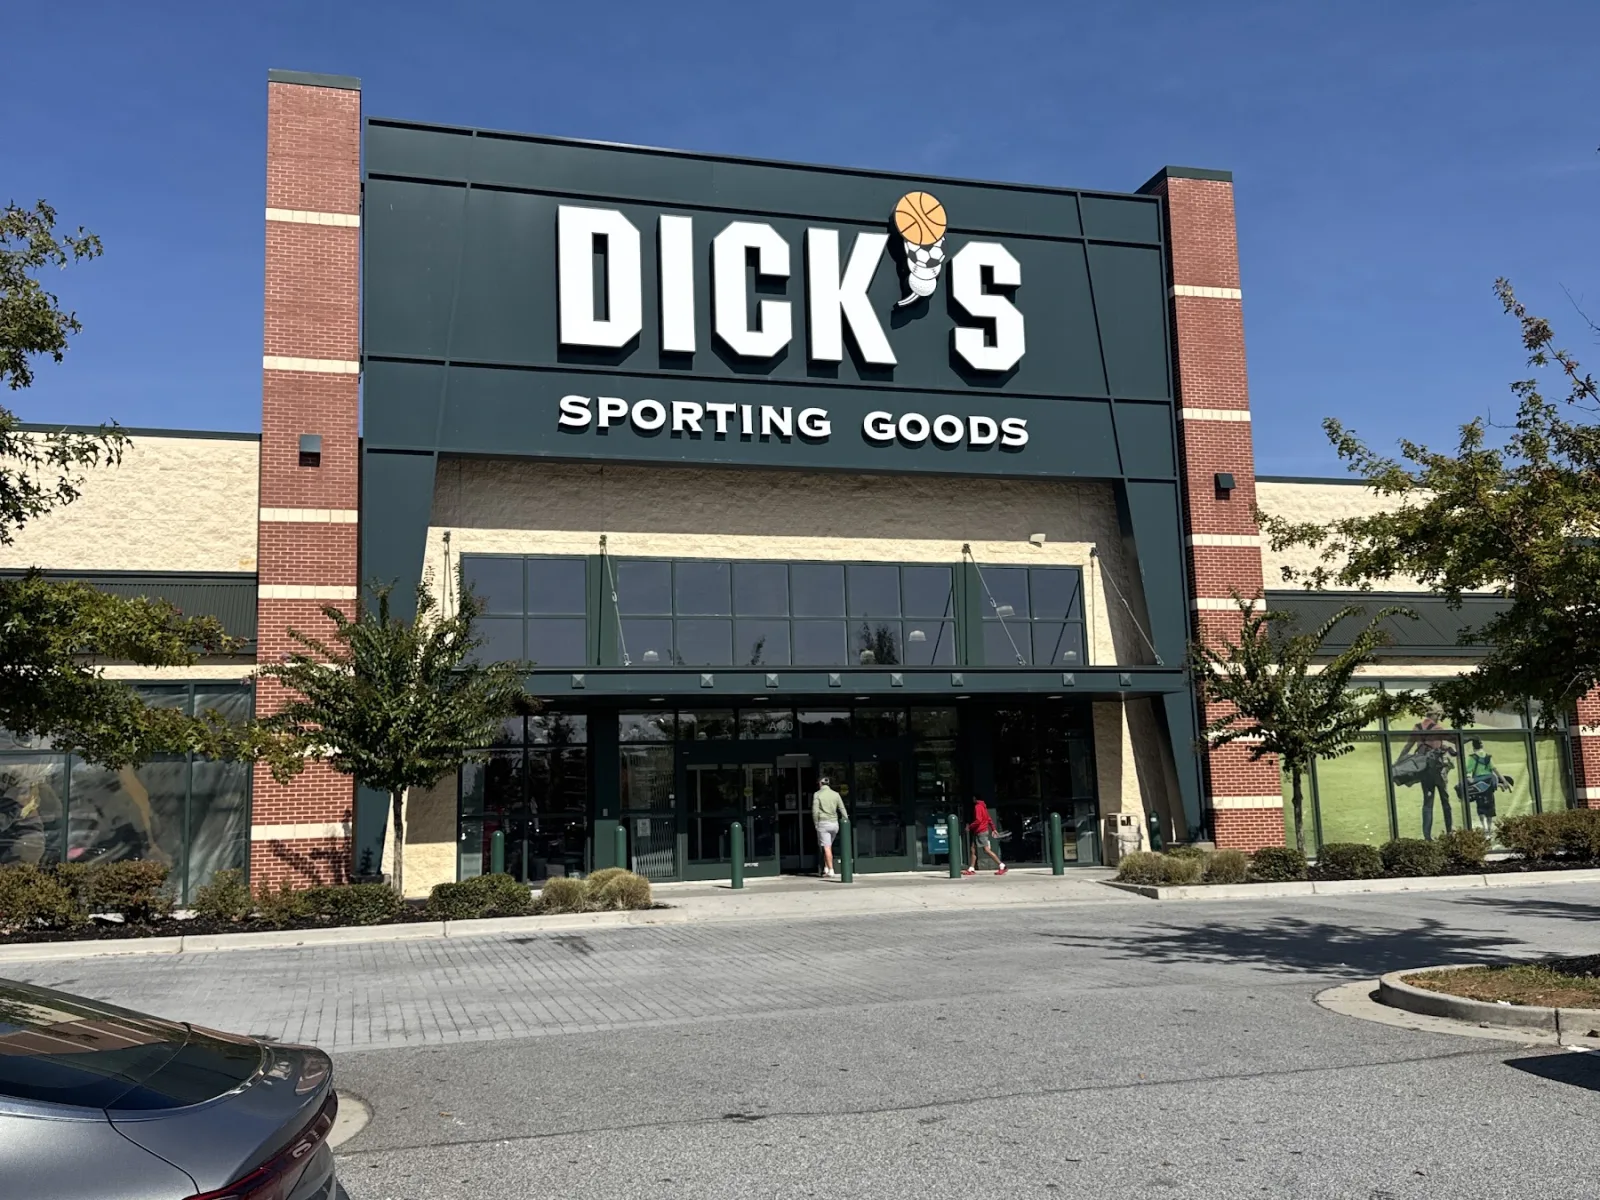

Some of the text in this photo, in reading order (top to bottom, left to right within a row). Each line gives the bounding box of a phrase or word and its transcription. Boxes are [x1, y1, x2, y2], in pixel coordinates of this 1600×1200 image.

[558, 191, 1026, 371] DICK'S
[558, 394, 1029, 446] SPORTING GOODS
